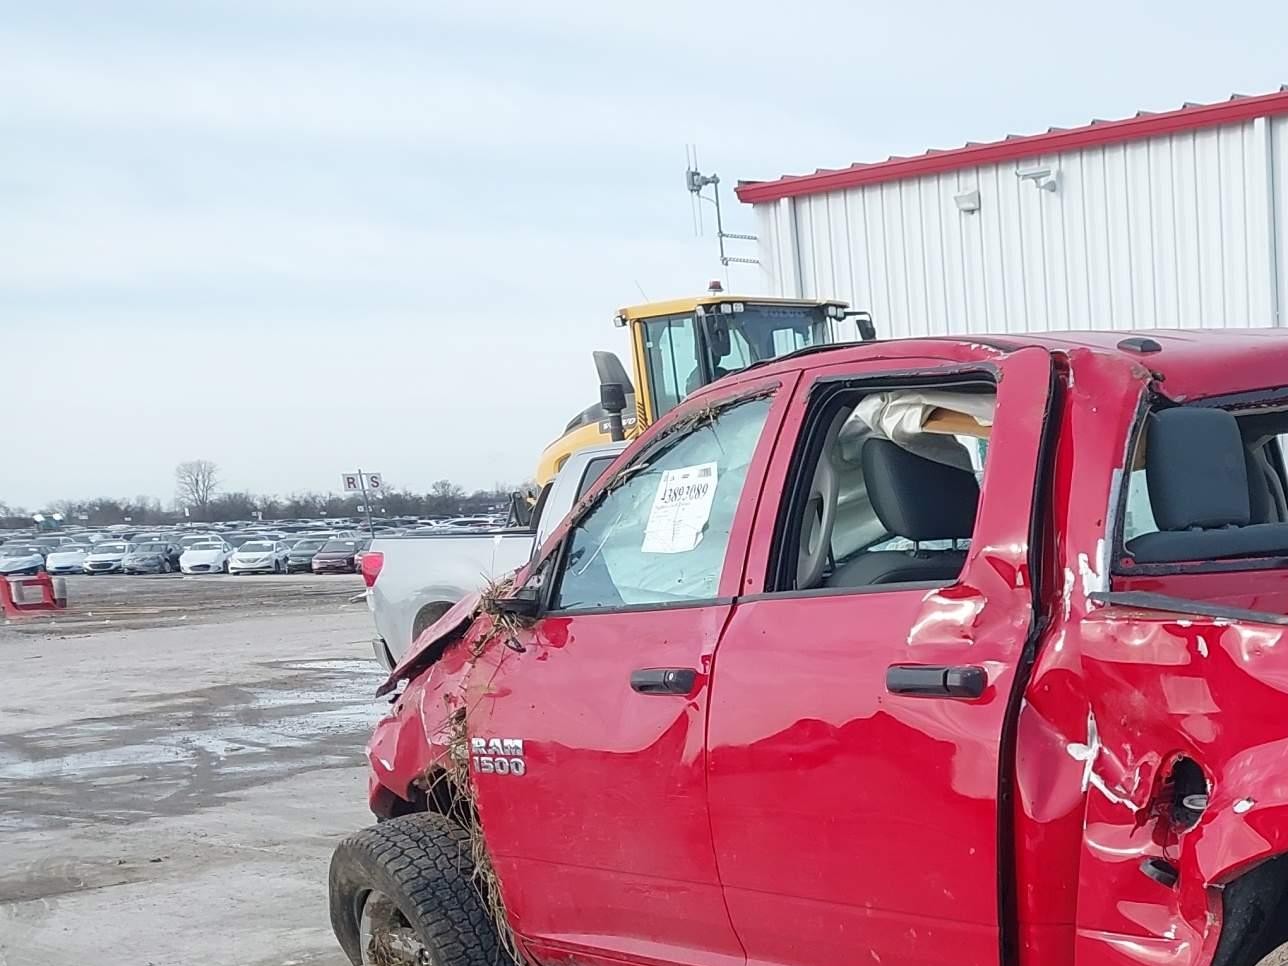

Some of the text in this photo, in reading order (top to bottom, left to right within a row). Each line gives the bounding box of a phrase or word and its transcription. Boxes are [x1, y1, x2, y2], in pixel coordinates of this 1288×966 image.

[346, 476, 357, 489] R
[370, 475, 380, 488] S
[471, 737, 523, 756] RAM
[472, 756, 526, 776] 1500
